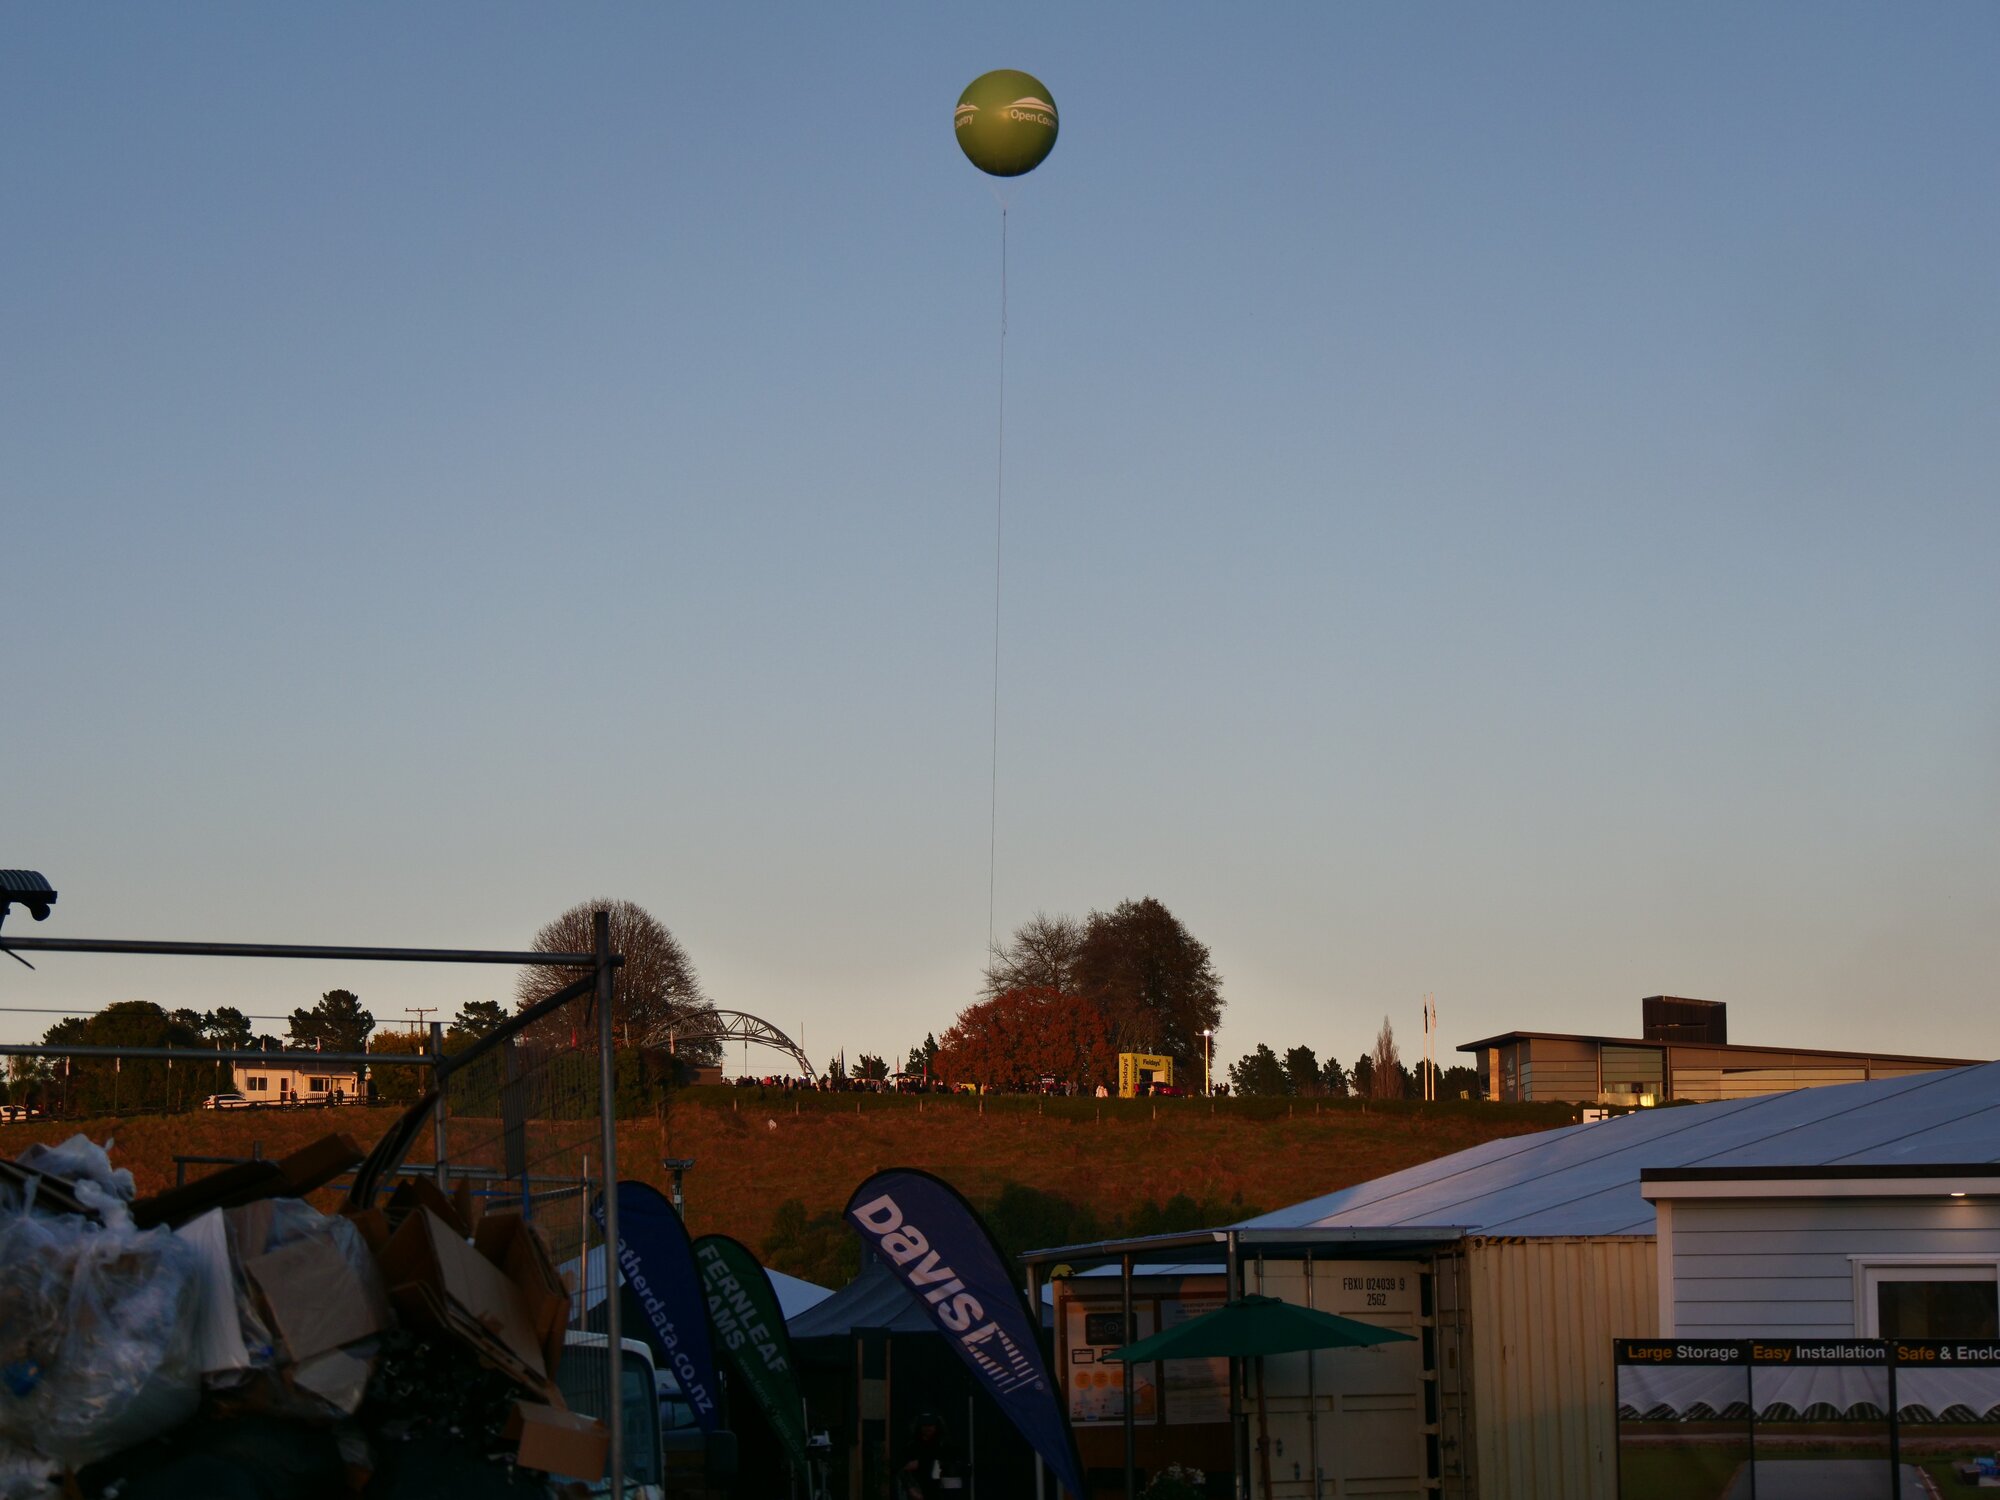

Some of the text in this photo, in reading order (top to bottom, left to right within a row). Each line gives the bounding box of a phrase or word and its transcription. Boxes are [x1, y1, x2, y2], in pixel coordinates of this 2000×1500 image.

[1010, 109, 1036, 122] Open
[1343, 1277, 1405, 1291] FBXU 024039 9
[697, 1244, 789, 1373] FERNLEAF
[1627, 1345, 1739, 1362] Large Storage
[1752, 1345, 1886, 1362] Easy Installation
[1897, 1346, 1936, 1360] Safe
[1939, 1346, 1952, 1360] &
